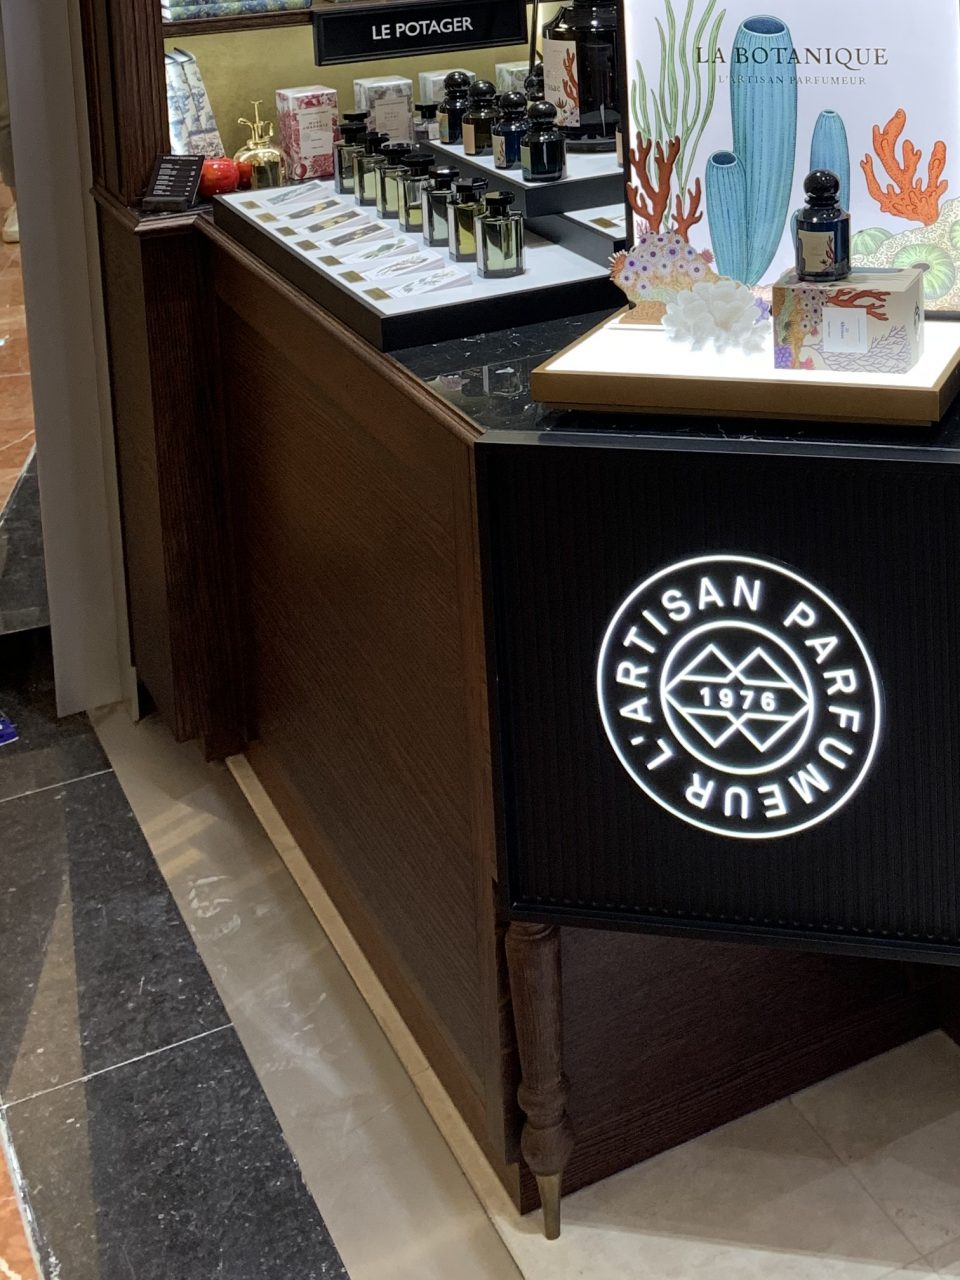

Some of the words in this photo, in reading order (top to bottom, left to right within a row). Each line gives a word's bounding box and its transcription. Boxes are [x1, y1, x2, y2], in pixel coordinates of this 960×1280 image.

[372, 24, 391, 40] LE
[395, 16, 474, 38] POTAGER
[695, 46, 727, 64] LA
[735, 47, 889, 71] BOTANIQUE
[718, 74, 784, 84] L'ARTISAN
[790, 75, 867, 85] PARFUMEUR
[615, 575, 761, 771] L'ARTISAN
[685, 600, 861, 820] PARFUMEUR
[700, 686, 777, 712] 1976
